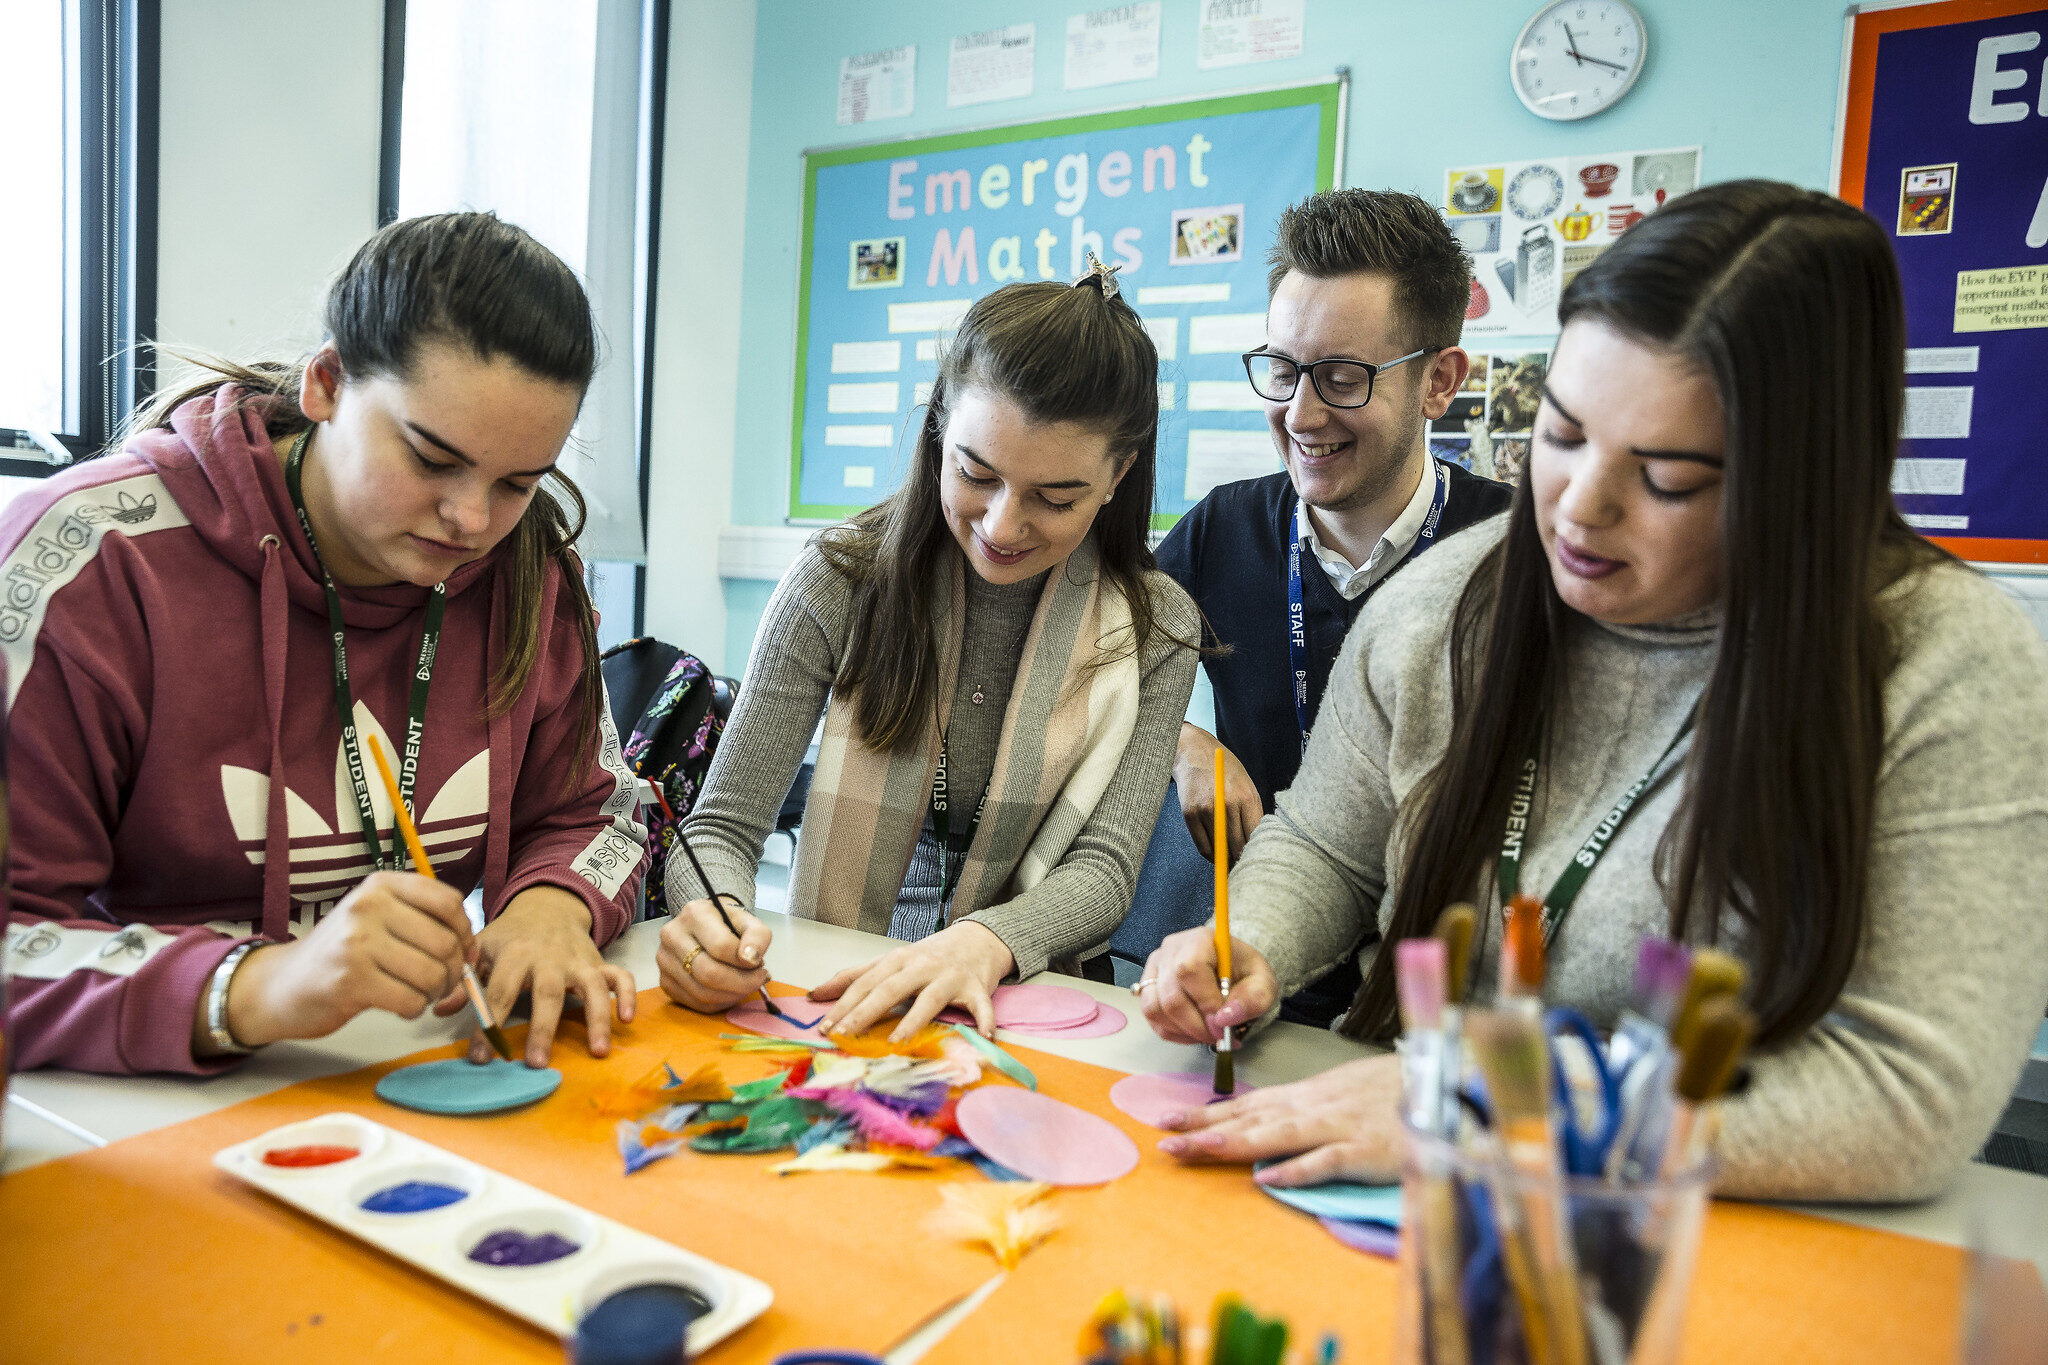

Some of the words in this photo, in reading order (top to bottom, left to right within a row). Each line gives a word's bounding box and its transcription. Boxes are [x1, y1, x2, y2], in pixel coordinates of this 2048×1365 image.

[1968, 31, 2048, 125] E
[887, 133, 1212, 221] Emergent
[926, 214, 1143, 287] Maths
[1961, 275, 1985, 287] How
[1989, 272, 2006, 285] the
[2008, 270, 2037, 284] EYP
[1956, 302, 2008, 315] emergent
[2012, 299, 2048, 312] mathe
[1958, 286, 2036, 303] opportunities
[1990, 312, 2048, 326] developme
[0, 504, 108, 643] adidas
[418, 633, 430, 665] TRESHAM
[1290, 602, 1305, 648] STAFF
[343, 725, 374, 820] STUDENT
[933, 740, 948, 812] STUDEN
